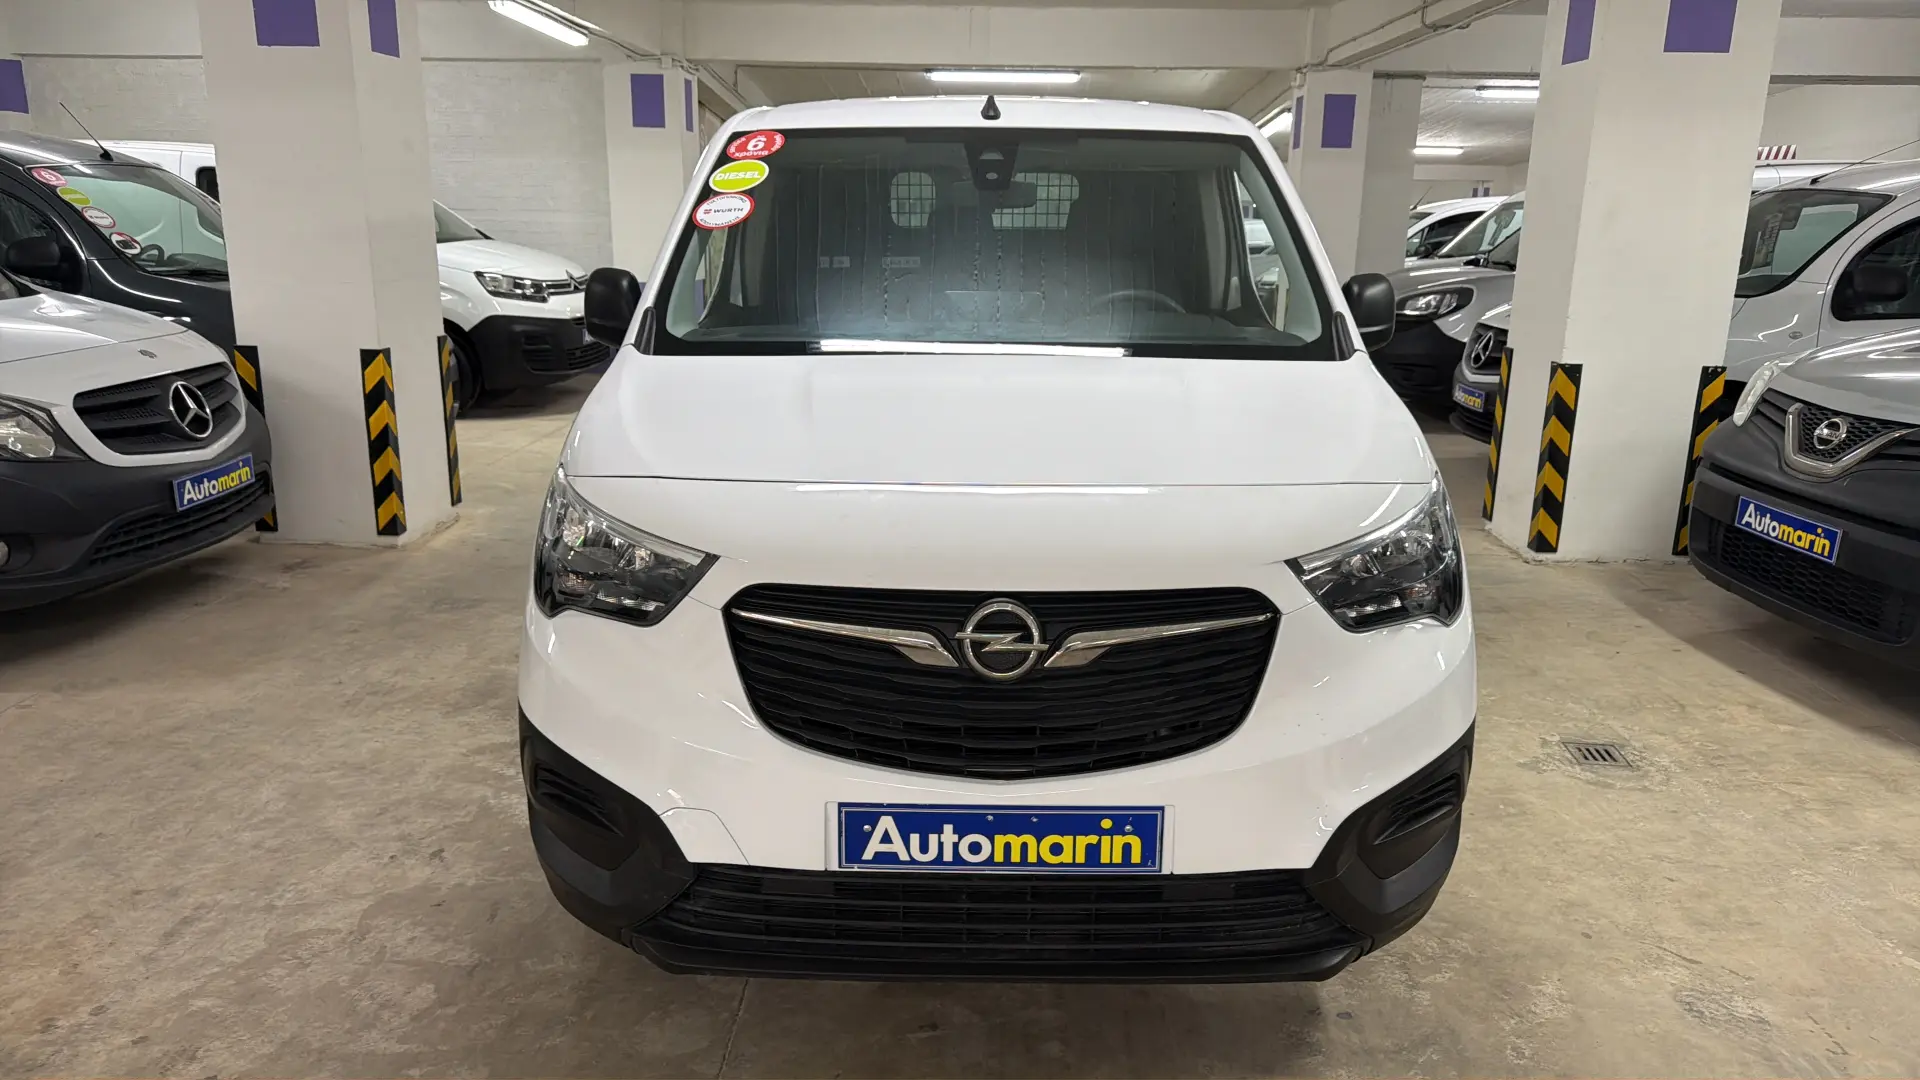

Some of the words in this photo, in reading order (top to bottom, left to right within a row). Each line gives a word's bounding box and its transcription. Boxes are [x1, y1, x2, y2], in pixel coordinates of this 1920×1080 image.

[746, 137, 767, 151] 6
[714, 171, 761, 181] DIESEL
[183, 461, 252, 505] Automarin
[1741, 502, 1831, 557] Automarin
[861, 815, 1142, 864] Automarin
